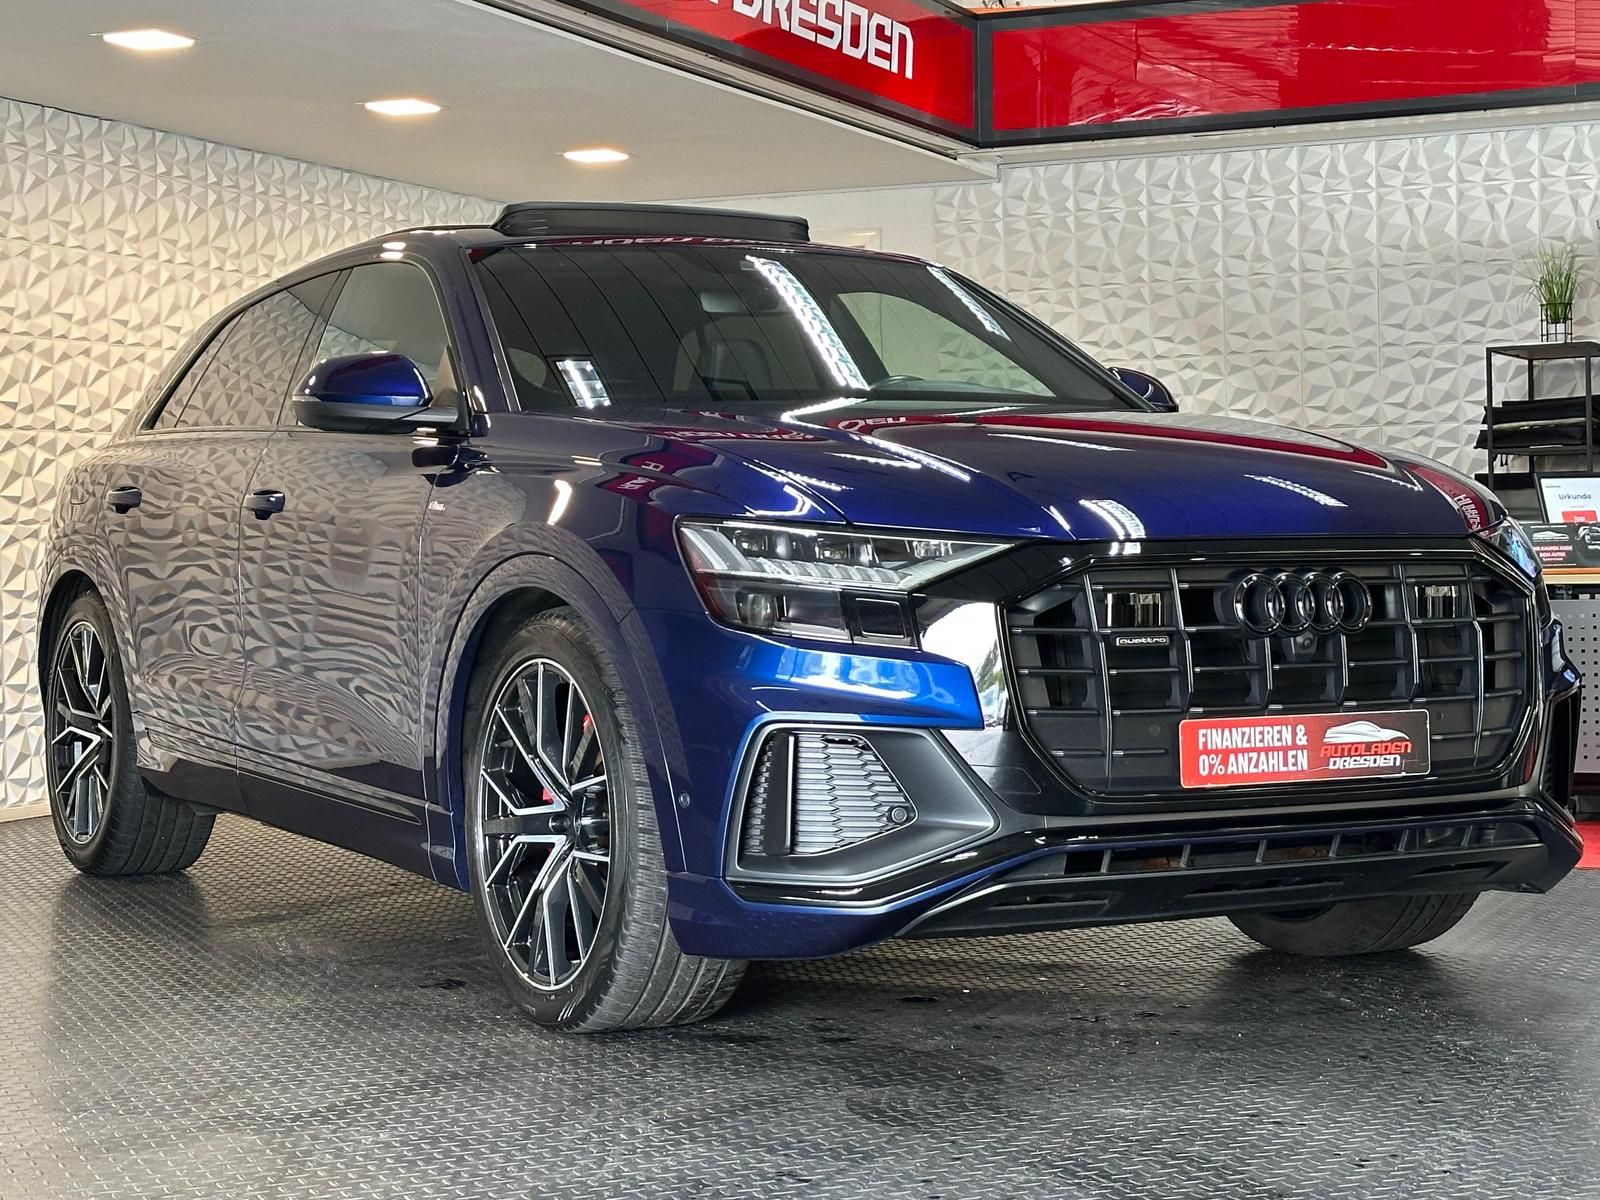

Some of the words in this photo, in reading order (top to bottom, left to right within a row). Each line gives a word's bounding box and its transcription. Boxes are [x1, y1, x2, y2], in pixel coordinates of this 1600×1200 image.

[1119, 637, 1167, 645] quattro
[1198, 725, 1292, 750] FINANZIEREN
[1296, 724, 1308, 746] &
[1320, 741, 1412, 758] AUTOLADEN
[1198, 754, 1225, 776] 0%
[1228, 750, 1308, 775] ANZAHLEN
[1328, 754, 1401, 769] DRESDEN
